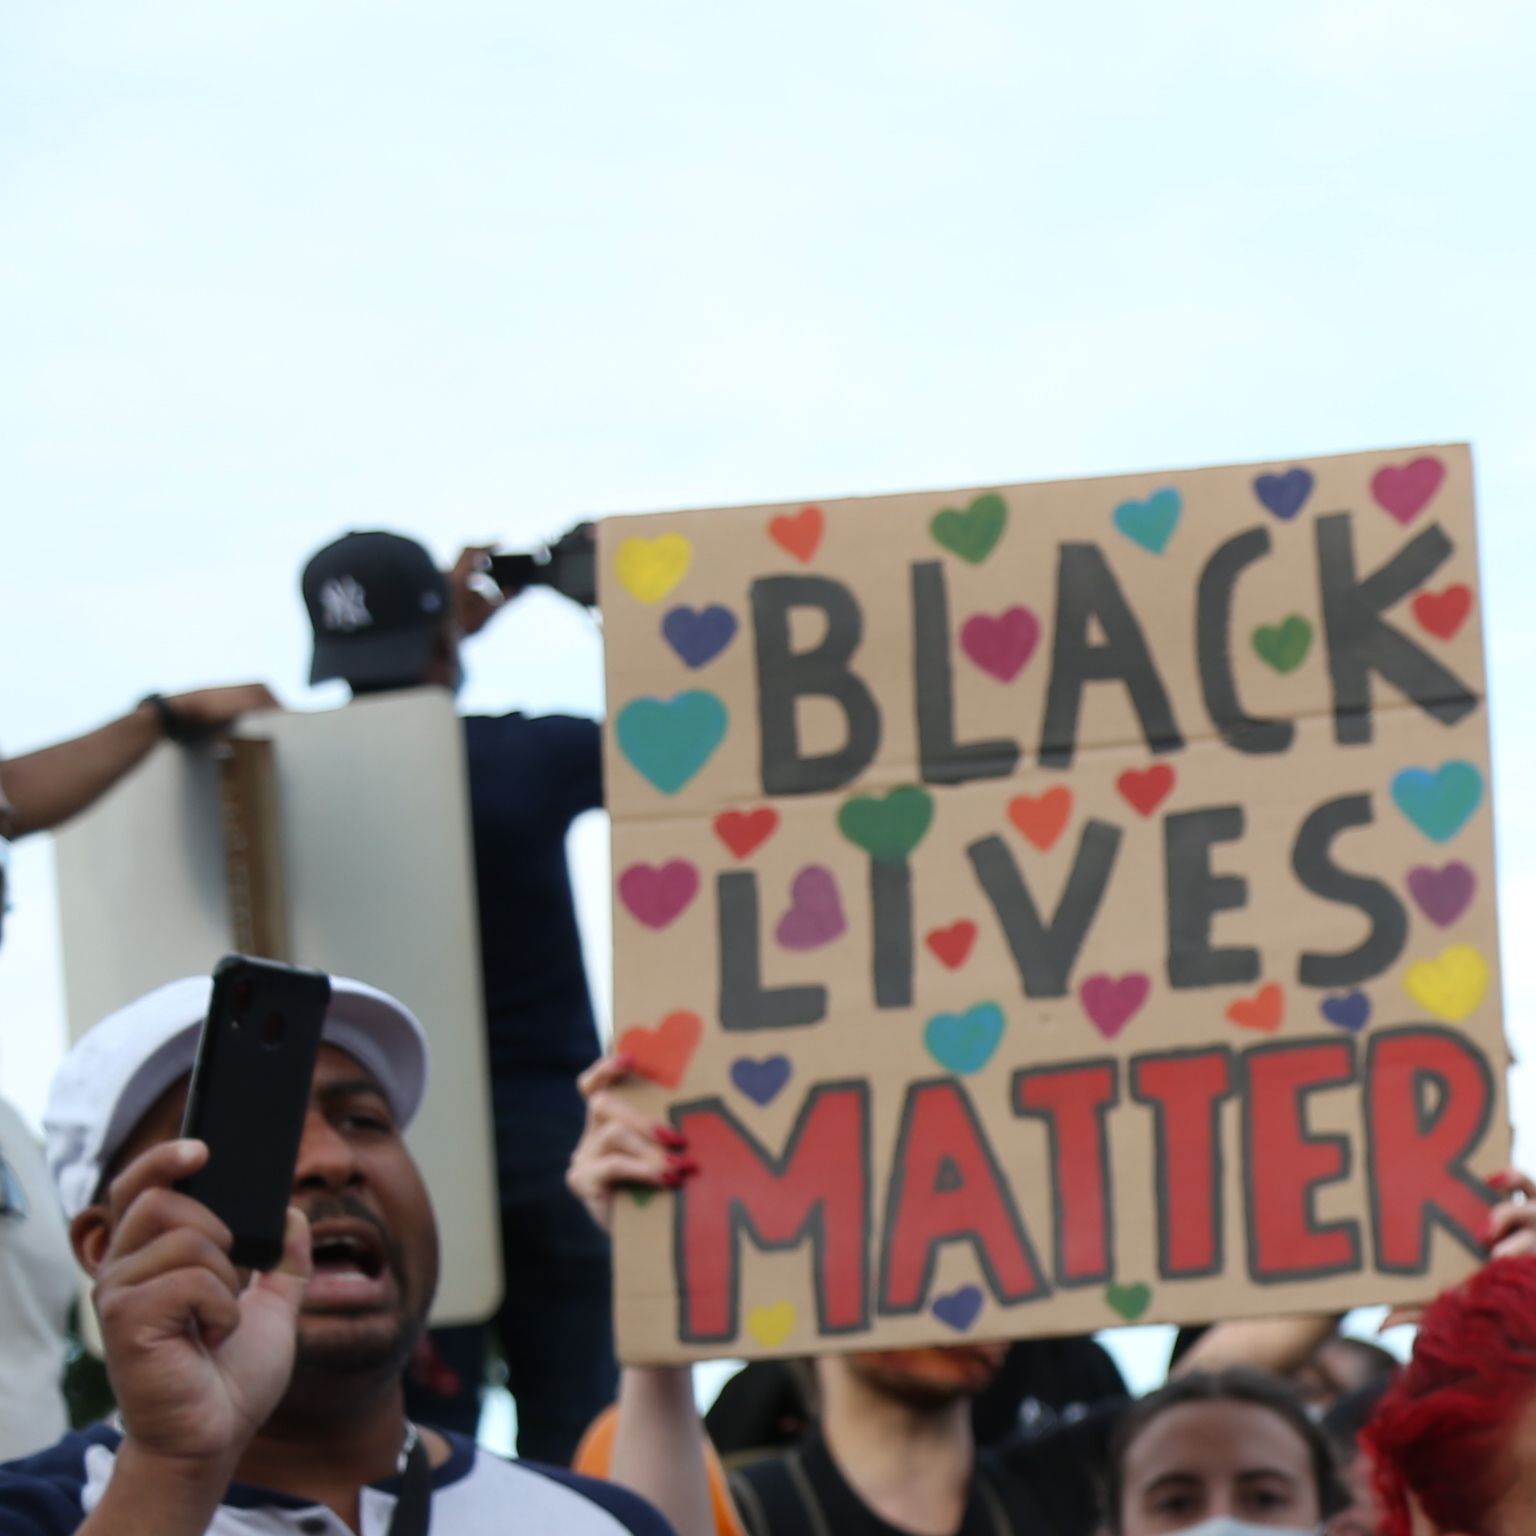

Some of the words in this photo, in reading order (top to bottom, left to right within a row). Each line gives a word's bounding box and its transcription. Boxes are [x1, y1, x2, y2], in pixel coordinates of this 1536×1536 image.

[749, 511, 1480, 796] BLACK
[716, 791, 1410, 1032] LIVES
[670, 1024, 1500, 1346] MATTER
